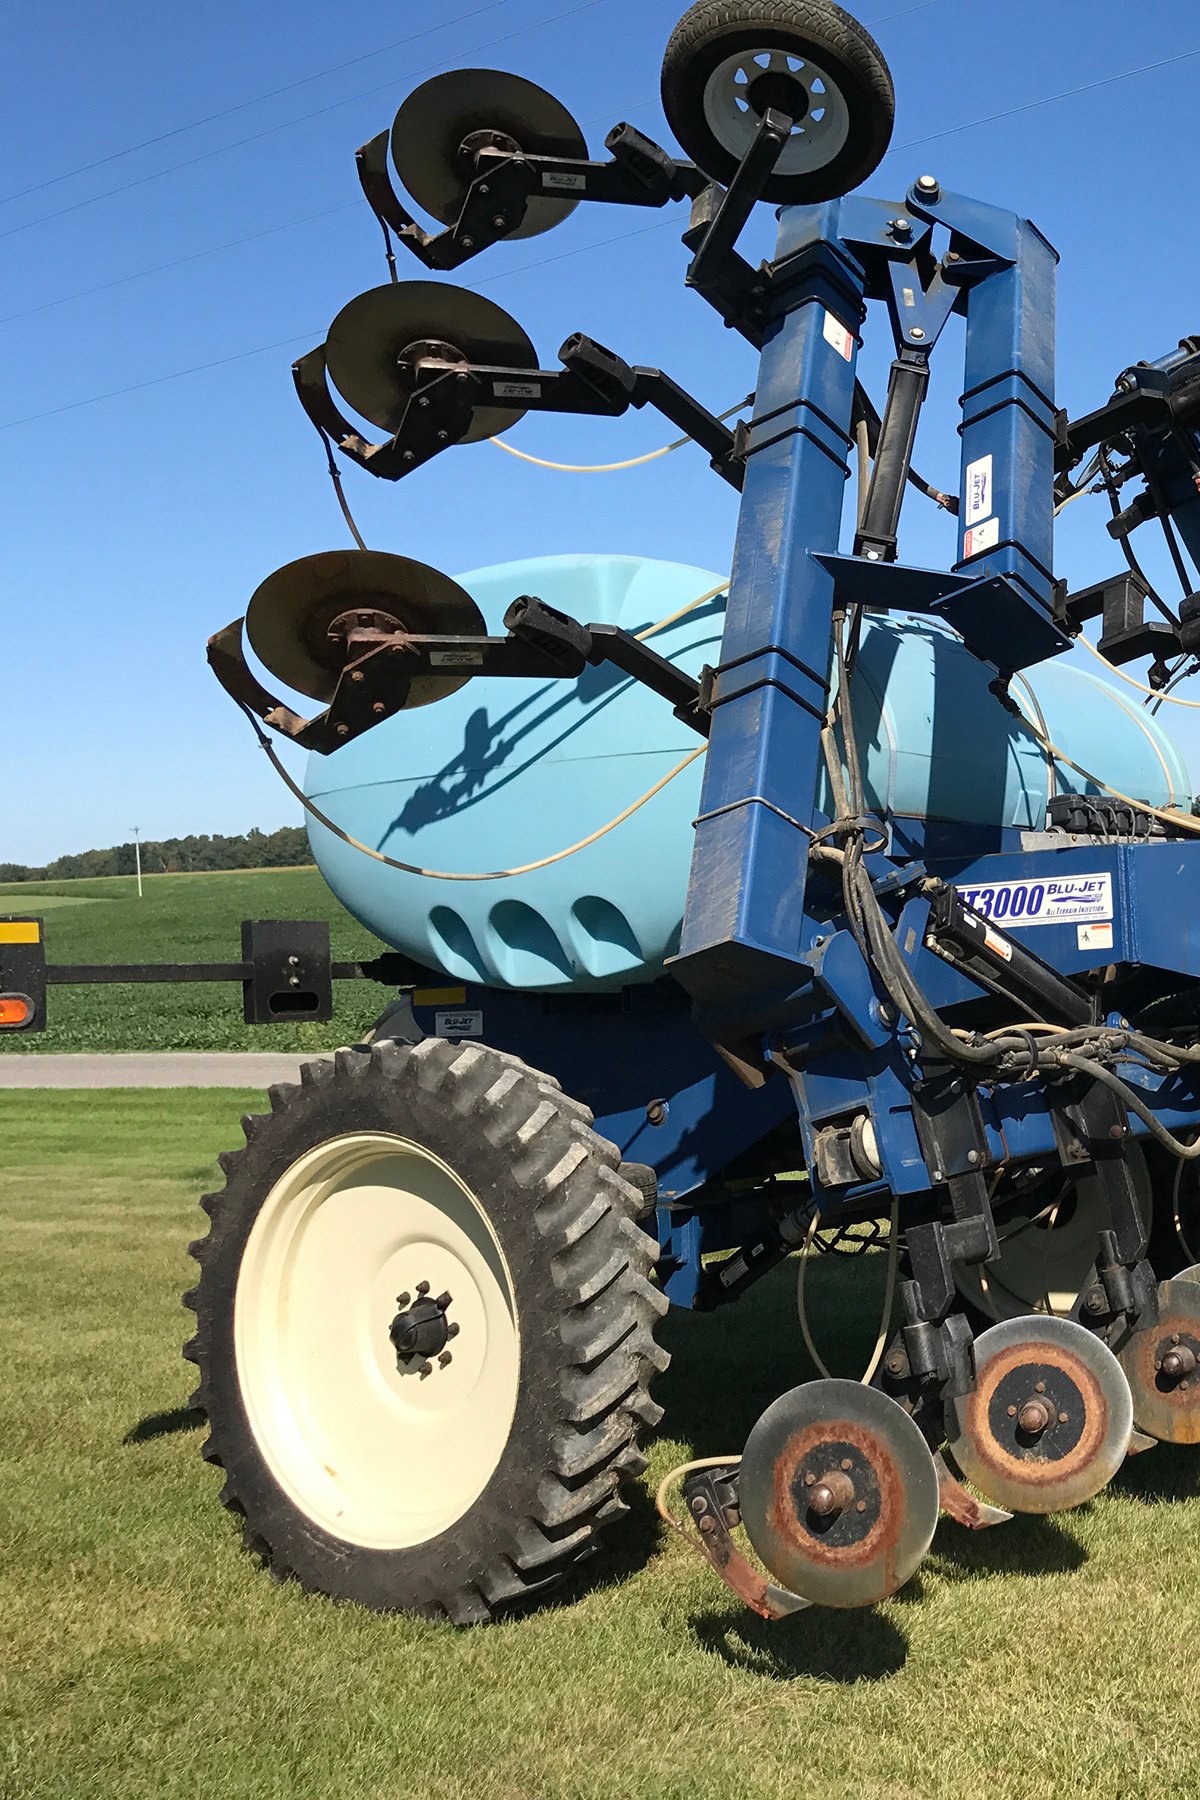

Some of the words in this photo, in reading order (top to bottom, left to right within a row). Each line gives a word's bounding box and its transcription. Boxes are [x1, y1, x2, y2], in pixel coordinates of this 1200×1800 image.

[1046, 881, 1106, 895] BLU-JET
[957, 885, 1045, 918] T3000
[1056, 906, 1077, 915] TERRAIN
[1079, 905, 1104, 913] INJECTION
